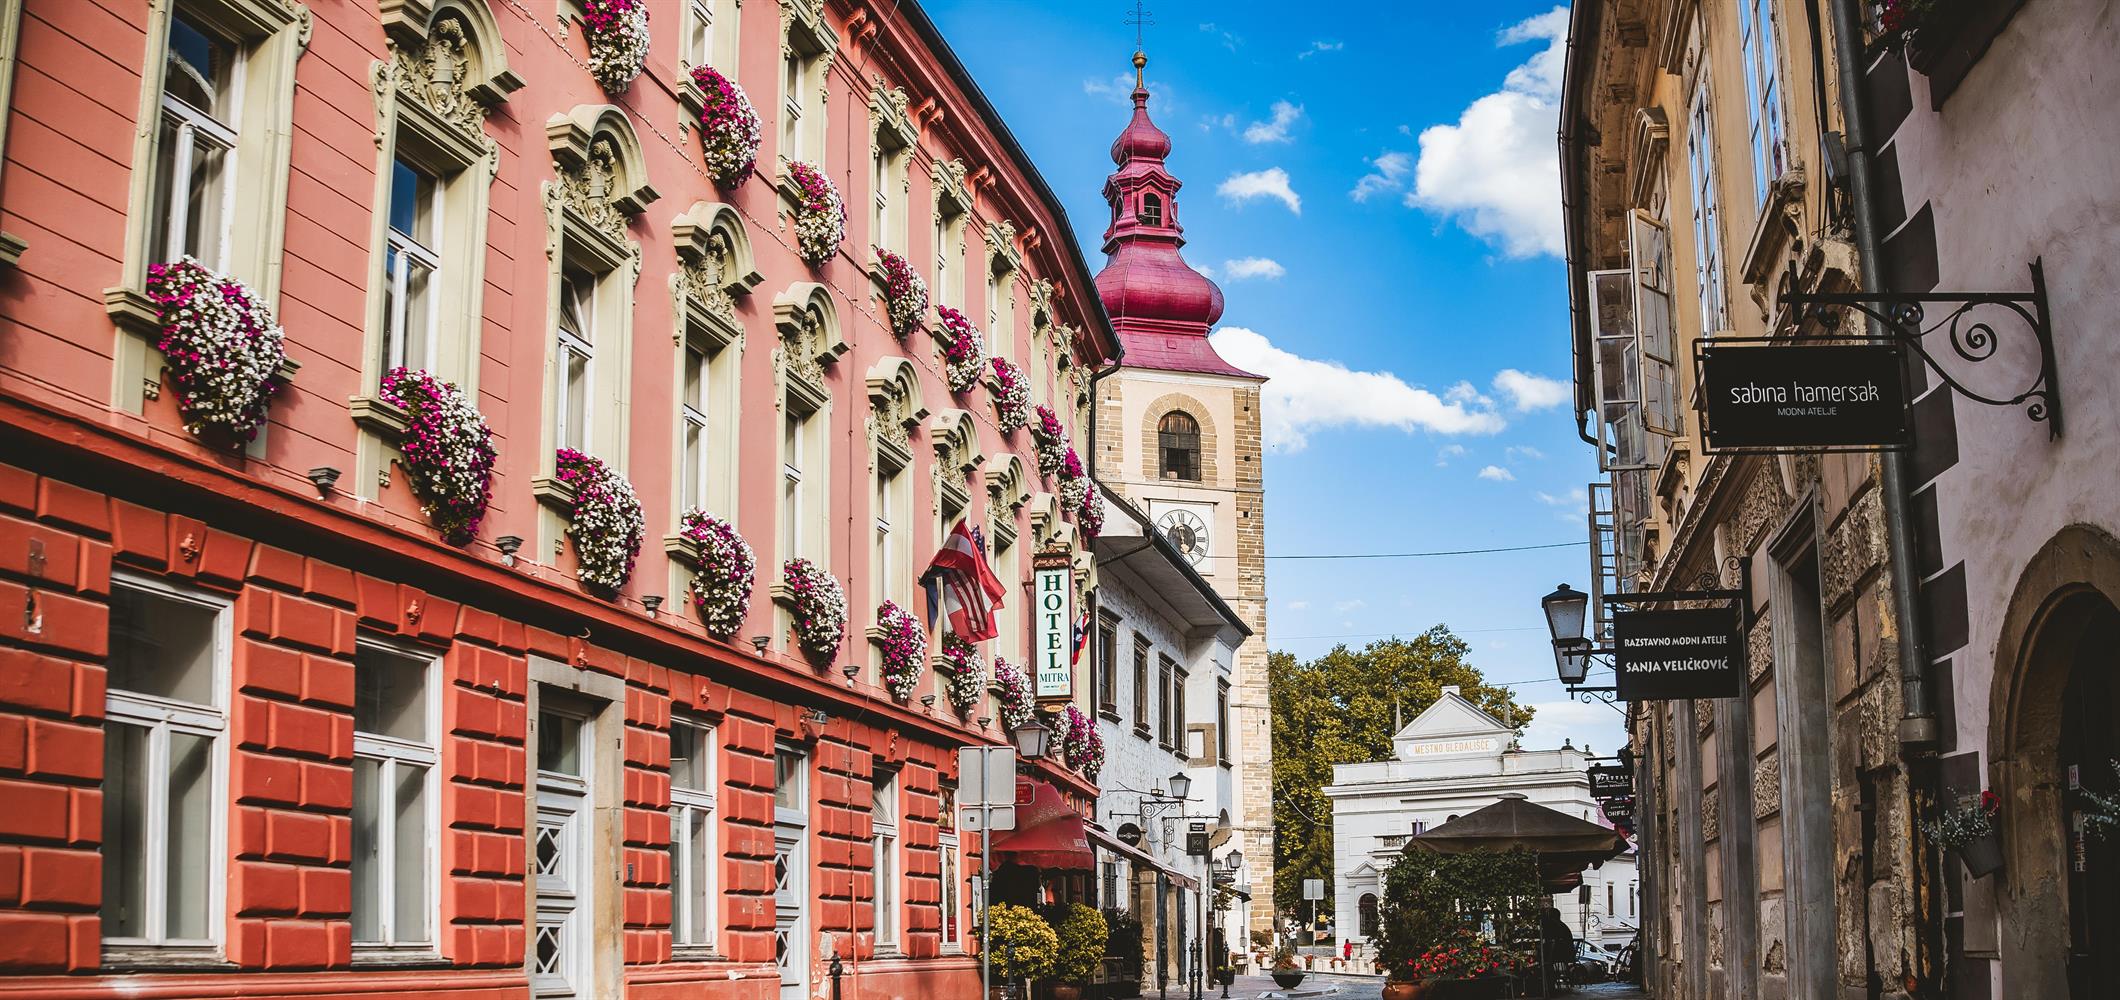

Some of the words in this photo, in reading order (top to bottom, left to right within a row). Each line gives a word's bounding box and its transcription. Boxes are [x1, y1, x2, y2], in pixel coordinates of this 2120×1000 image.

[1730, 381, 1787, 404] sabina
[1777, 407, 1806, 417] MODNI
[1807, 406, 1838, 416] ATELJE
[1043, 574, 1063, 670] HOTEL
[1624, 637, 1671, 647] RAZSTAVNO
[1672, 636, 1700, 646] MODNI
[1701, 635, 1728, 645] ATELJE
[1625, 661, 1662, 673] SANJA
[1663, 656, 1729, 672] VELIČKOVIĆ
[1039, 672, 1070, 683] MITRA
[1414, 743, 1443, 755] MESTNO
